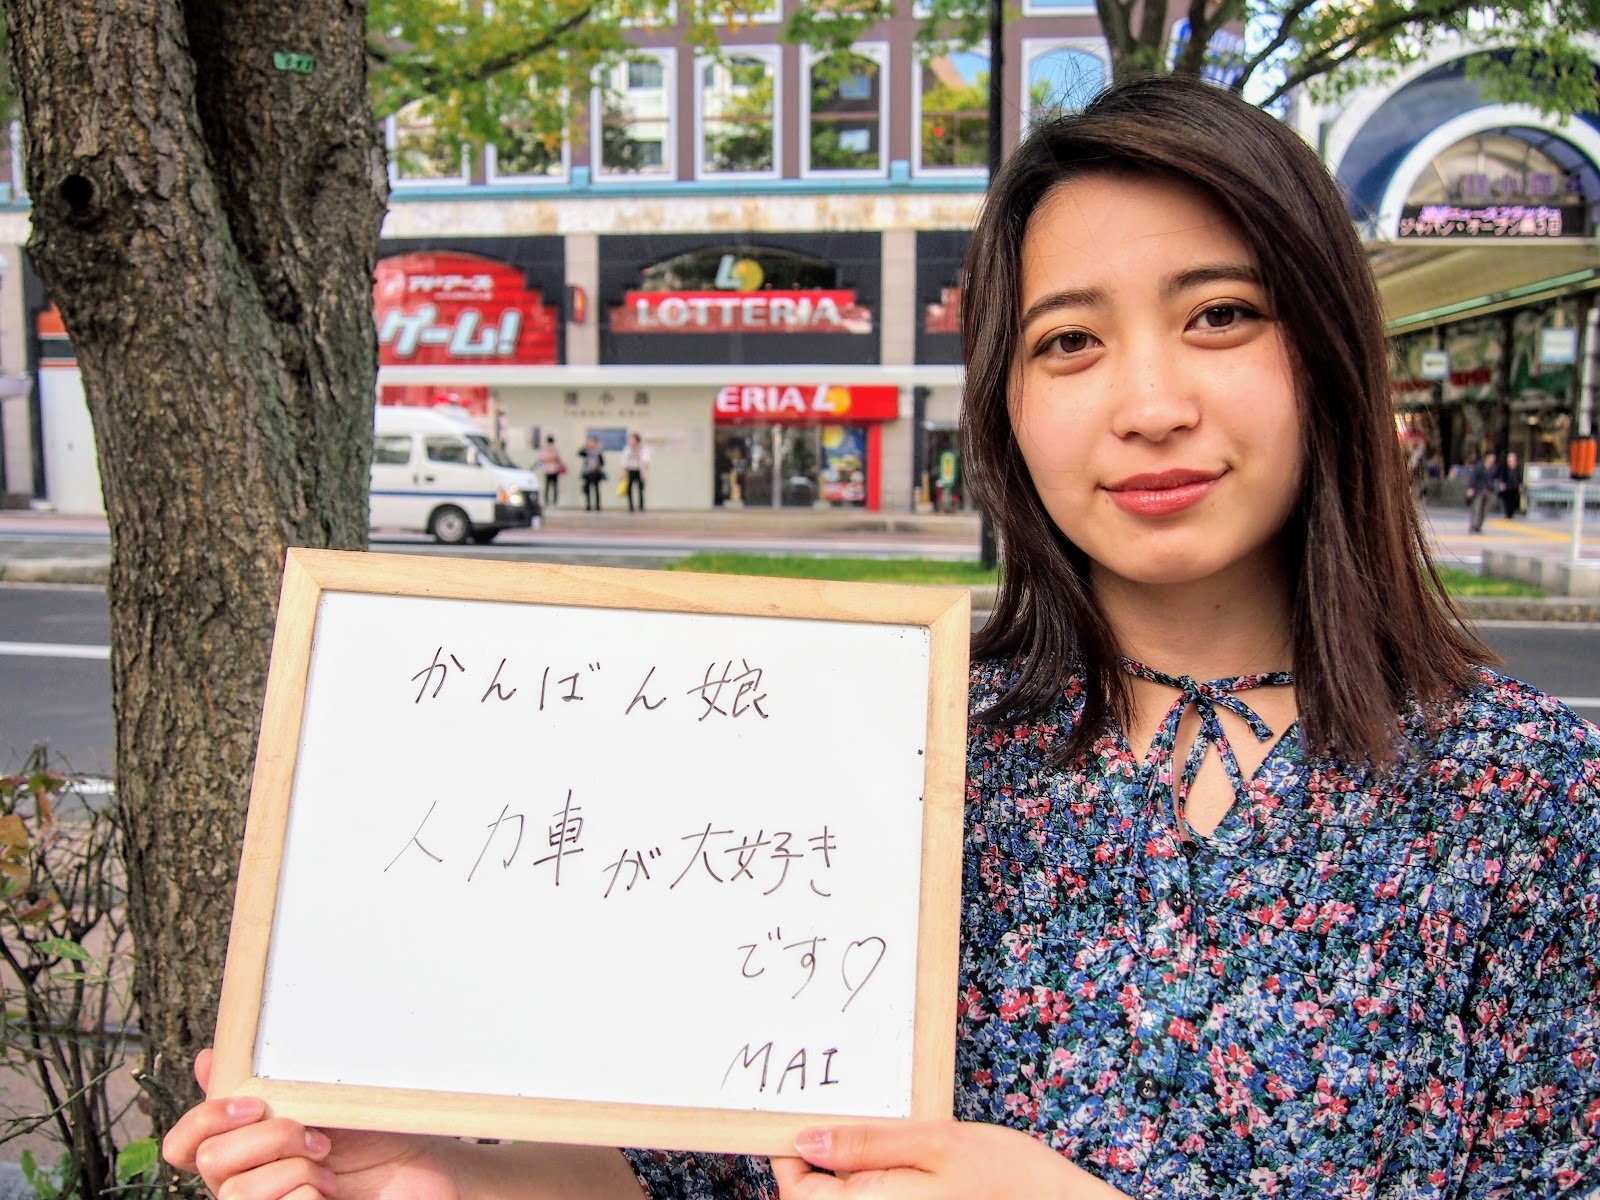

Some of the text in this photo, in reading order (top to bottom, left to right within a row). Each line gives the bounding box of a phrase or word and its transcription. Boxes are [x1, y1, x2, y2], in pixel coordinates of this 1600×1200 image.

[636, 297, 842, 326] LOTTERIA
[716, 385, 806, 413] ERIA
[411, 646, 769, 721] かんばん娘
[383, 789, 837, 899] 人力車が大好き
[737, 926, 827, 999] です
[720, 1041, 839, 1095] MAI
